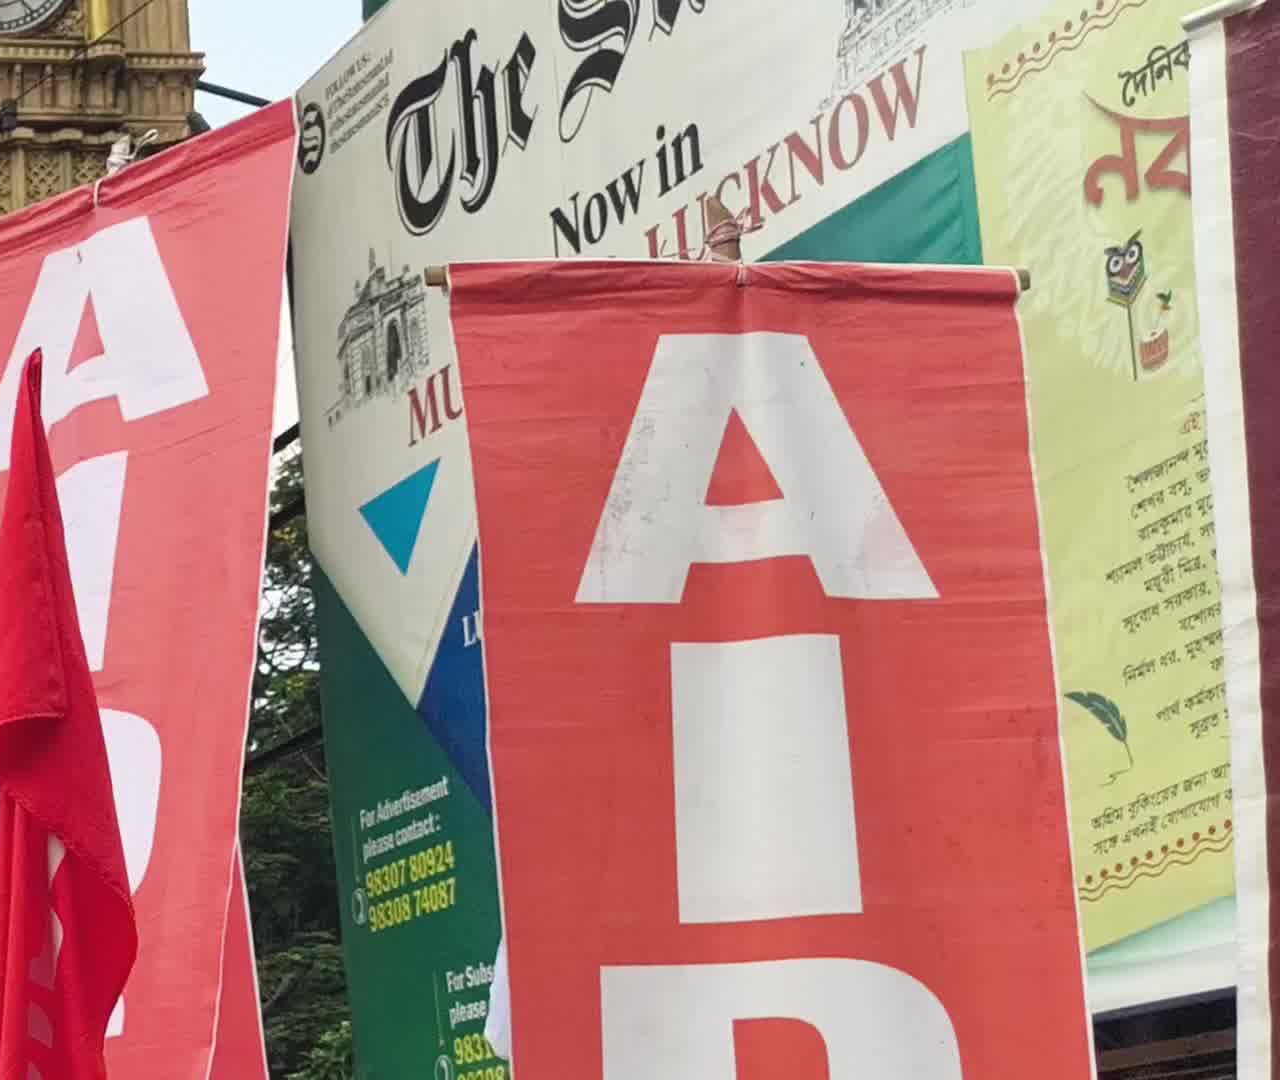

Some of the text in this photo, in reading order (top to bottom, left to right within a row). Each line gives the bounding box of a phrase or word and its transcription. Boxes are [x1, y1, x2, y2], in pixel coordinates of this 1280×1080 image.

[387, 28, 538, 236] The
[549, 122, 704, 258] Now in
[376, 776, 449, 815] Advertisement
[362, 837, 395, 863] please
[365, 863, 407, 899] 98307
[414, 877, 457, 914] 74087
[450, 999, 488, 1031] please
